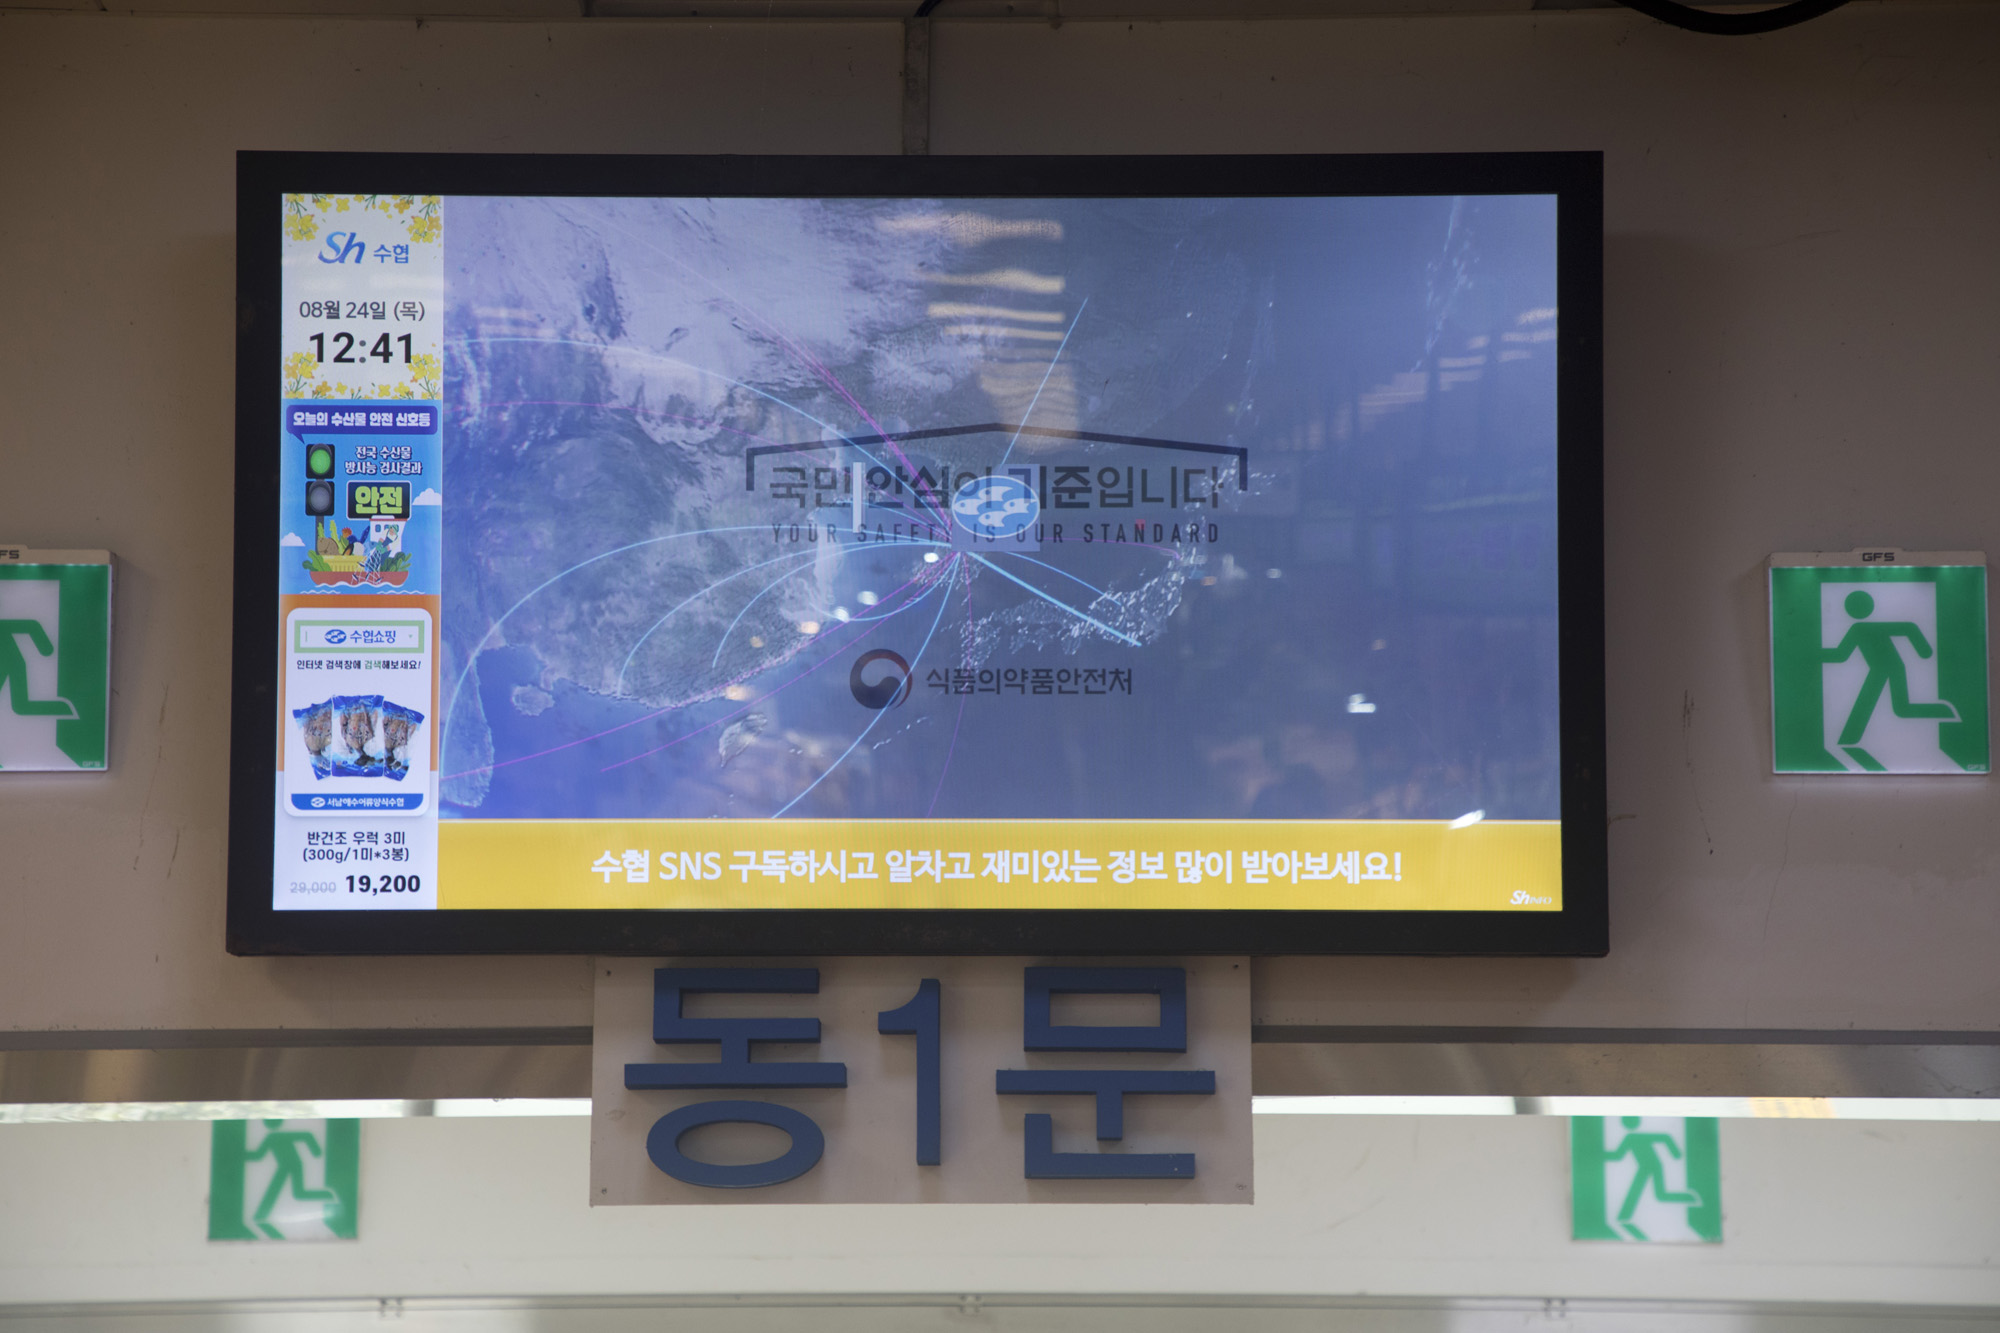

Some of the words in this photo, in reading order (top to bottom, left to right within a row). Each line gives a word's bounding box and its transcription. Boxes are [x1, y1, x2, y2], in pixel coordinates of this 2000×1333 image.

[318, 231, 366, 264] Sh
[373, 244, 409, 264] 수협
[299, 300, 340, 320] 08월
[345, 300, 386, 320] 24일
[393, 301, 425, 322] (목)
[309, 331, 412, 364] 12:41
[293, 411, 328, 427] 오늘의
[331, 412, 366, 427] 수산물
[369, 412, 393, 427] 안전
[396, 412, 431, 427] 신호등
[355, 446, 377, 460] 전국
[379, 446, 412, 460] 수산물
[344, 461, 377, 475] 방사능
[379, 461, 423, 475] 검사결과
[769, 466, 855, 509] 국민
[865, 465, 992, 509] 안심이
[1007, 466, 1225, 510] 기준입니다
[355, 486, 403, 514] 안전
[772, 523, 838, 543] YOUR
[972, 523, 996, 543] IS
[1015, 523, 1064, 543] OUR
[1082, 523, 1219, 543] STANDARD
[0, 549, 20, 559] FS
[1861, 552, 1895, 562] GFS
[349, 630, 396, 644] 수협쇼핑
[296, 660, 323, 670] 인터넷
[325, 660, 361, 670] 검색창에
[926, 667, 1132, 695] 식품의약품안전처
[307, 831, 348, 846] 반건조
[352, 831, 379, 846] 우럭
[384, 831, 406, 846] 3미
[591, 849, 650, 883] 수협
[659, 852, 722, 880] SNS
[729, 850, 878, 884] 구독하시고
[885, 849, 975, 883] 알차고
[981, 850, 1101, 884] 재미있는
[1107, 851, 1168, 884] 정보
[1174, 851, 1233, 884] 많이
[1240, 851, 1403, 884] 받아보세요!
[290, 881, 337, 895] 29,000
[345, 875, 421, 896] 19,200
